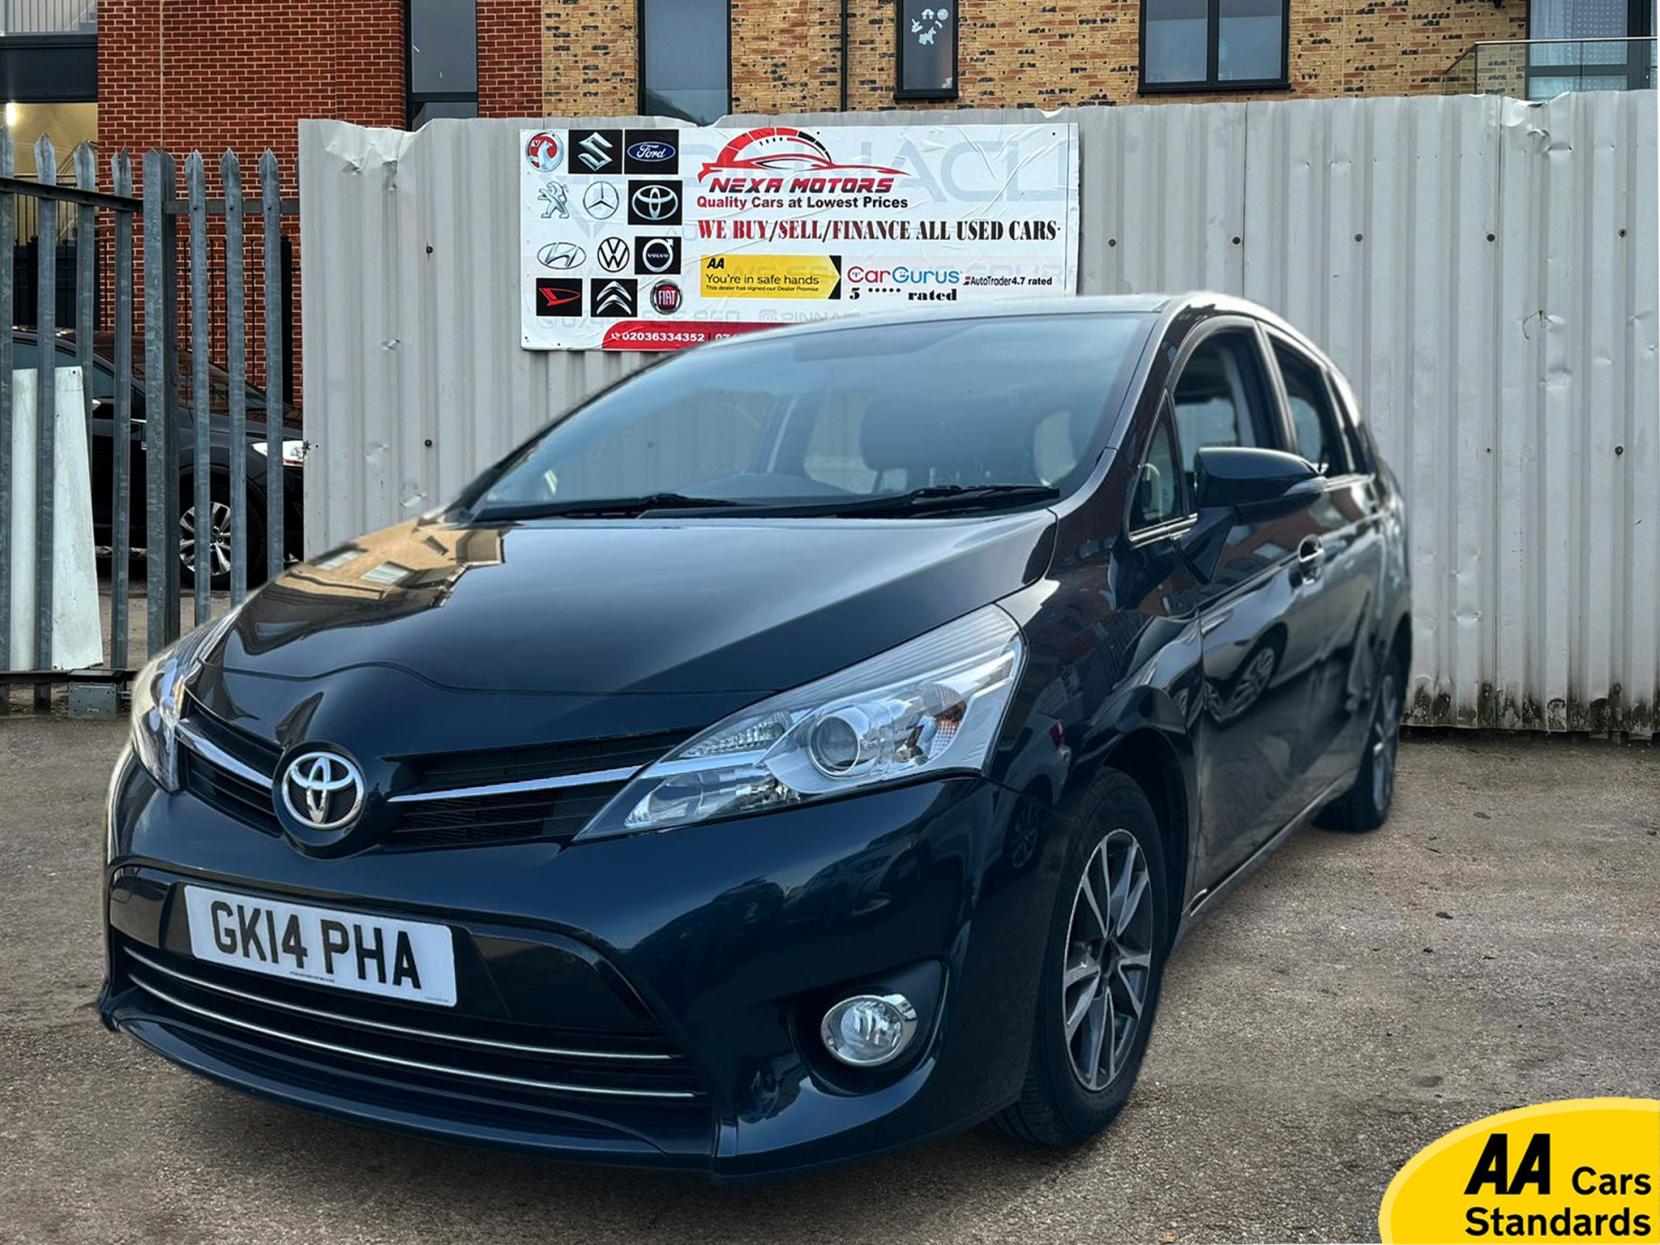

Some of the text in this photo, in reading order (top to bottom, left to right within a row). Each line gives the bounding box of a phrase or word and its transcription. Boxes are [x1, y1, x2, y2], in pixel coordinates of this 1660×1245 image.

[636, 143, 666, 159] Ford
[709, 178, 894, 193] NEXA MOTORS
[697, 196, 908, 210] Quality Cars at Lowest Prices
[698, 220, 726, 239] WE
[916, 220, 950, 240] ALL
[956, 221, 1003, 240] USED
[1009, 220, 1057, 240] CARS
[706, 257, 725, 269] AA
[706, 273, 820, 285] You're in safe hands
[847, 266, 960, 284] CarGurus
[1028, 277, 1053, 286] rated
[657, 290, 677, 306] FIAT
[849, 287, 957, 301] 5 rated
[622, 331, 705, 343] 02036334352
[210, 900, 422, 990] GK14 PHA
